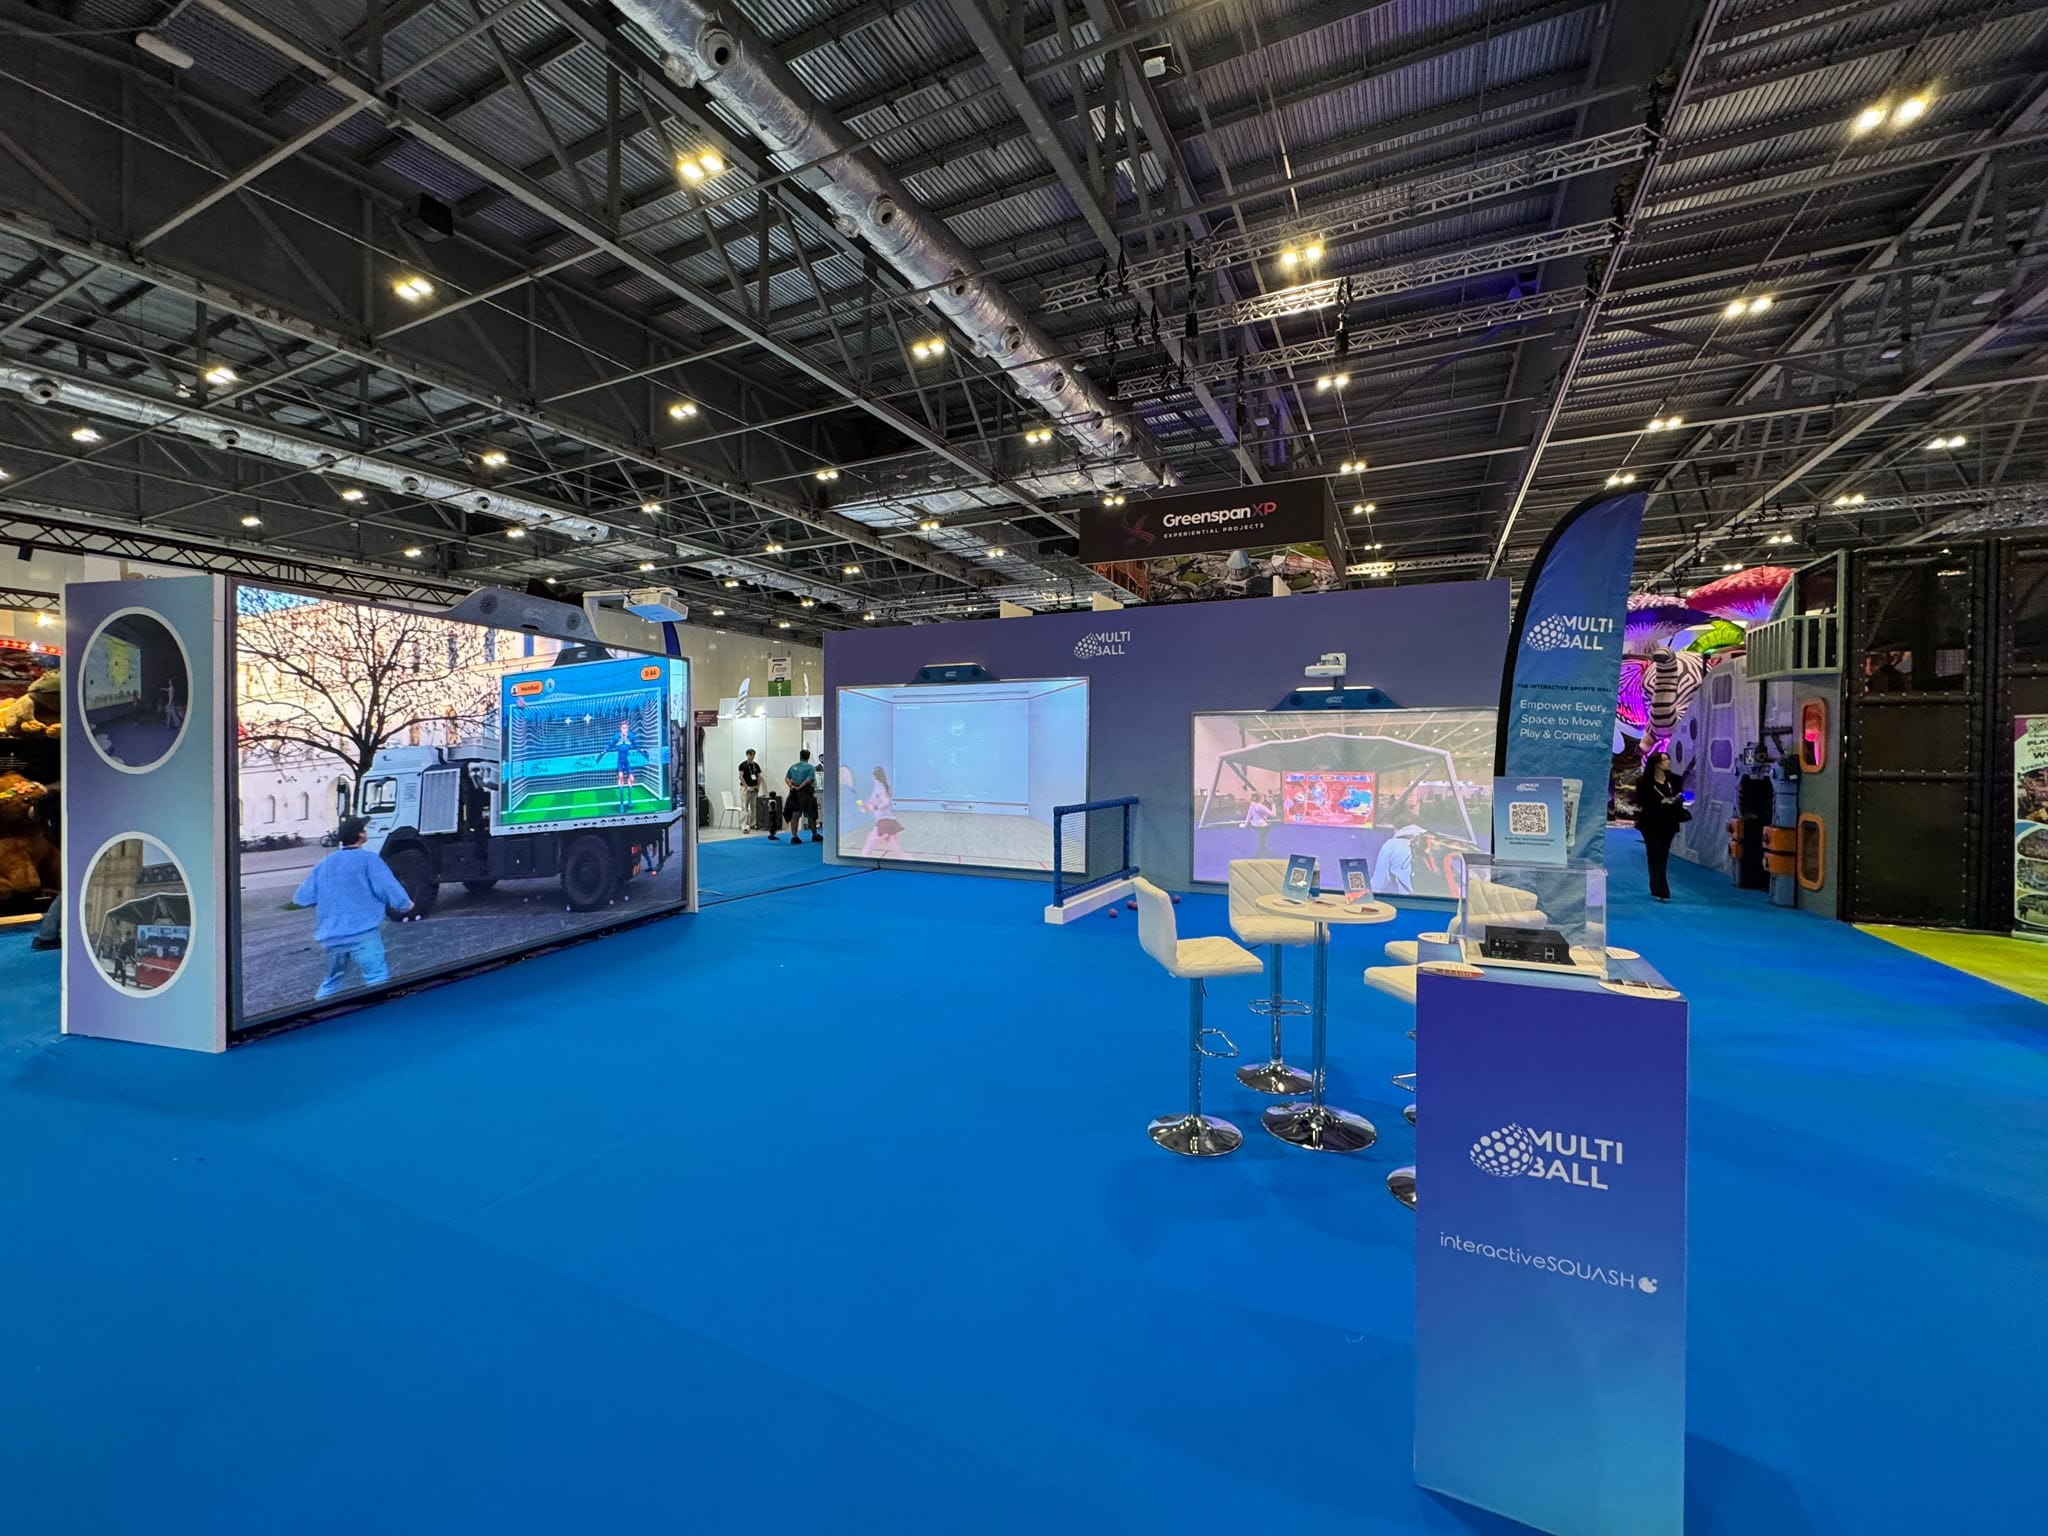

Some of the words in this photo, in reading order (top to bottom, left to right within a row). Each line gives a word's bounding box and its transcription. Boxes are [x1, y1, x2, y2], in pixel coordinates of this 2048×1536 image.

[1163, 528, 1219, 539] EXPERIENTIAL
[1223, 522, 1265, 533] PROJECTS
[1562, 615, 1613, 633] MULTI
[1095, 631, 1131, 643] MULTI
[1560, 634, 1603, 650] BALL
[1095, 644, 1126, 656] BALL
[1520, 699, 1572, 711] Empower
[1575, 702, 1607, 713] Every
[1521, 713, 1556, 726] Space
[1558, 714, 1569, 725] to
[1520, 728, 1541, 739] Play
[1543, 730, 1552, 739] &
[1527, 1127, 1623, 1165] MULTI
[1527, 1156, 1608, 1190] BALL
[1440, 1231, 1634, 1289] interactiveSQUASH
